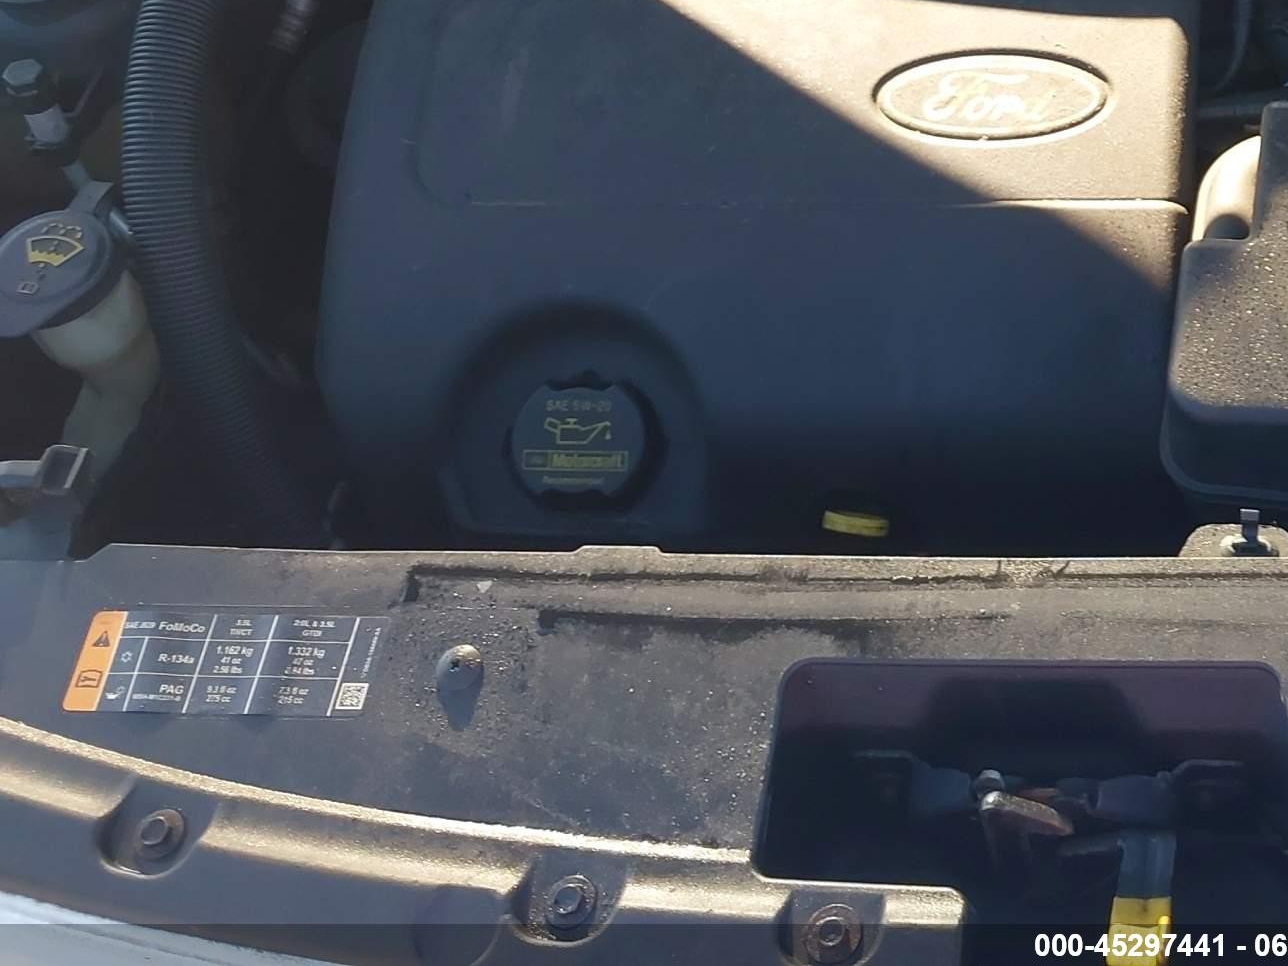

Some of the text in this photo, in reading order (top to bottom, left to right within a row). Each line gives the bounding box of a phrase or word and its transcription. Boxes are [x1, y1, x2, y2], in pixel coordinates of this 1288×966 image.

[923, 70, 1053, 122] Ford
[545, 400, 569, 412] SAE
[158, 622, 206, 633] FoMoCo
[241, 646, 254, 657] kg
[312, 647, 326, 659] kg
[157, 653, 195, 664] R-134a
[159, 684, 184, 695] PAG
